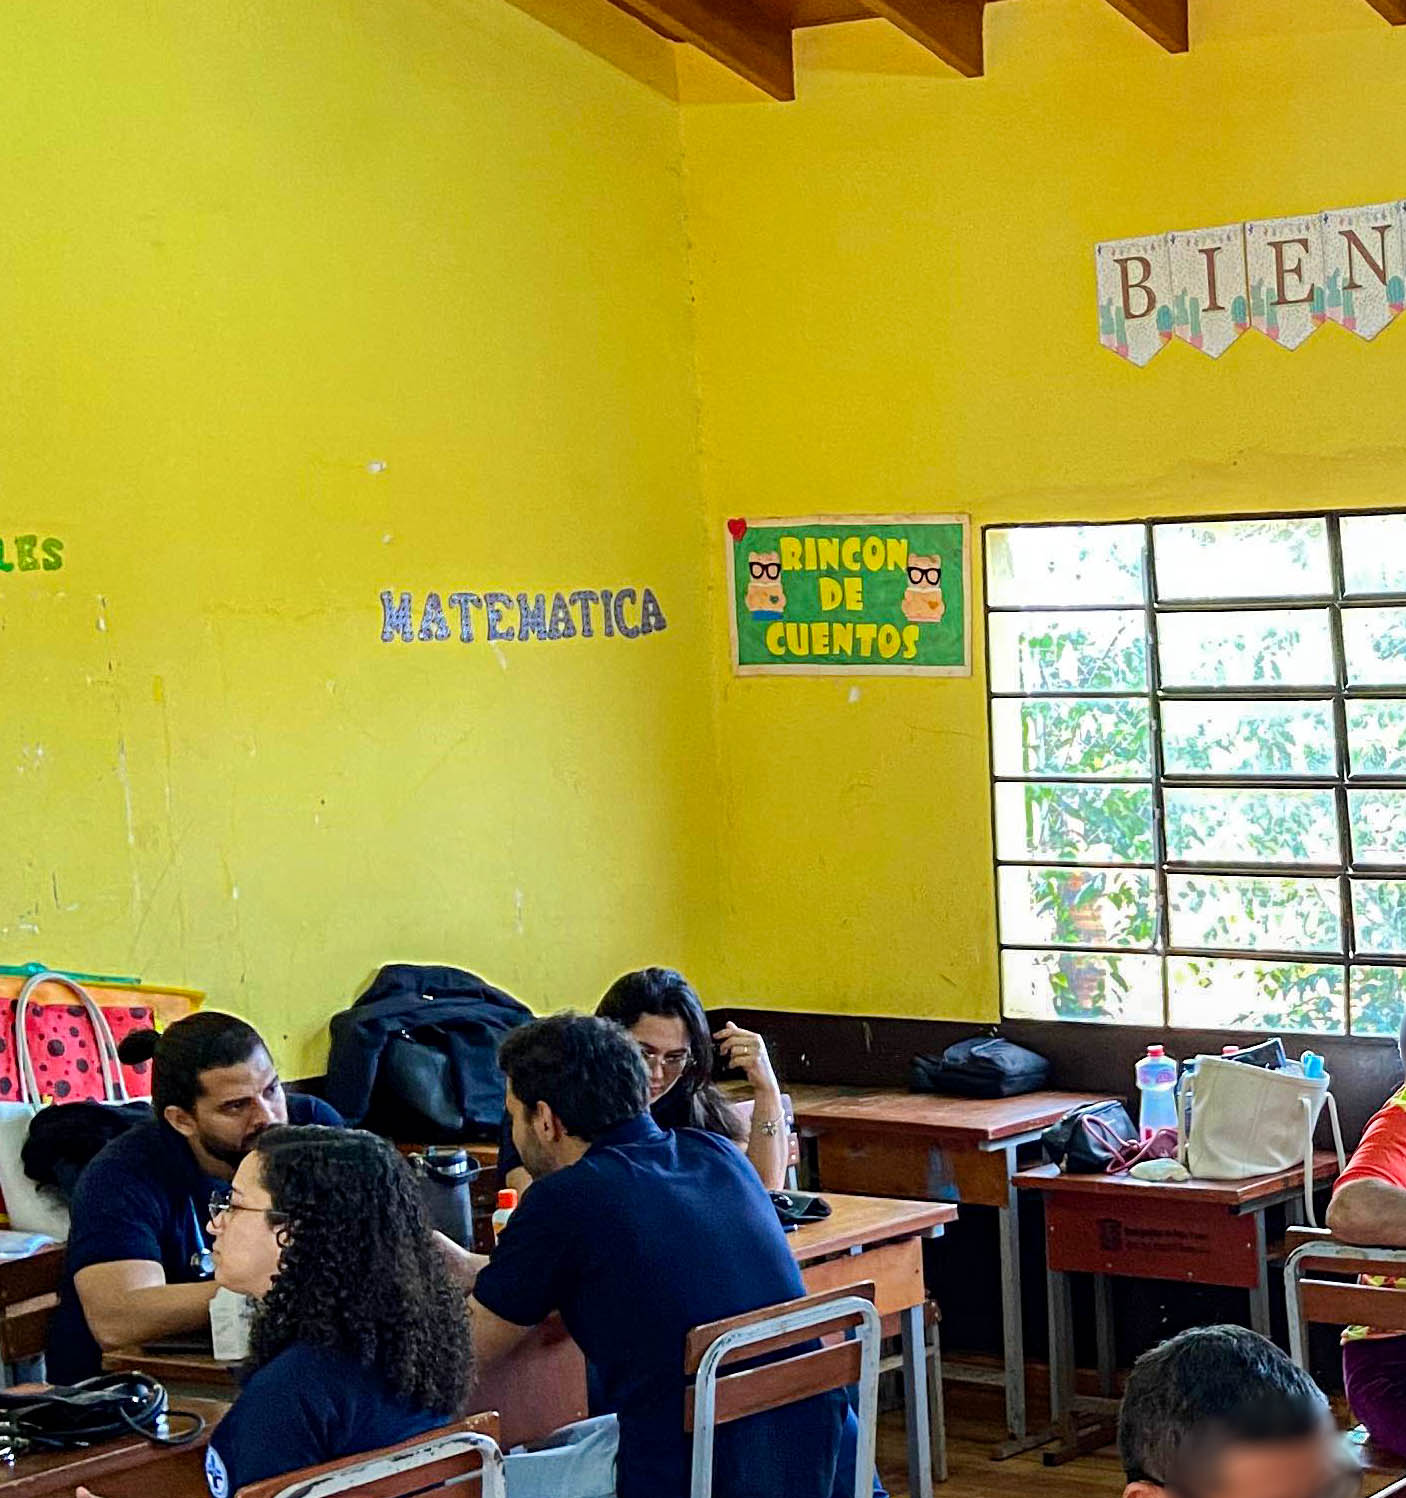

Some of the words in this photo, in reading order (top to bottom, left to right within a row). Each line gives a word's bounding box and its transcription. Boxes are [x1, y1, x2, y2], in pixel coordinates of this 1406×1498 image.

[778, 535, 909, 573] RINCON
[818, 576, 865, 612] DE
[379, 587, 668, 643] MATEMATICA
[765, 621, 920, 660] CUENTOS
